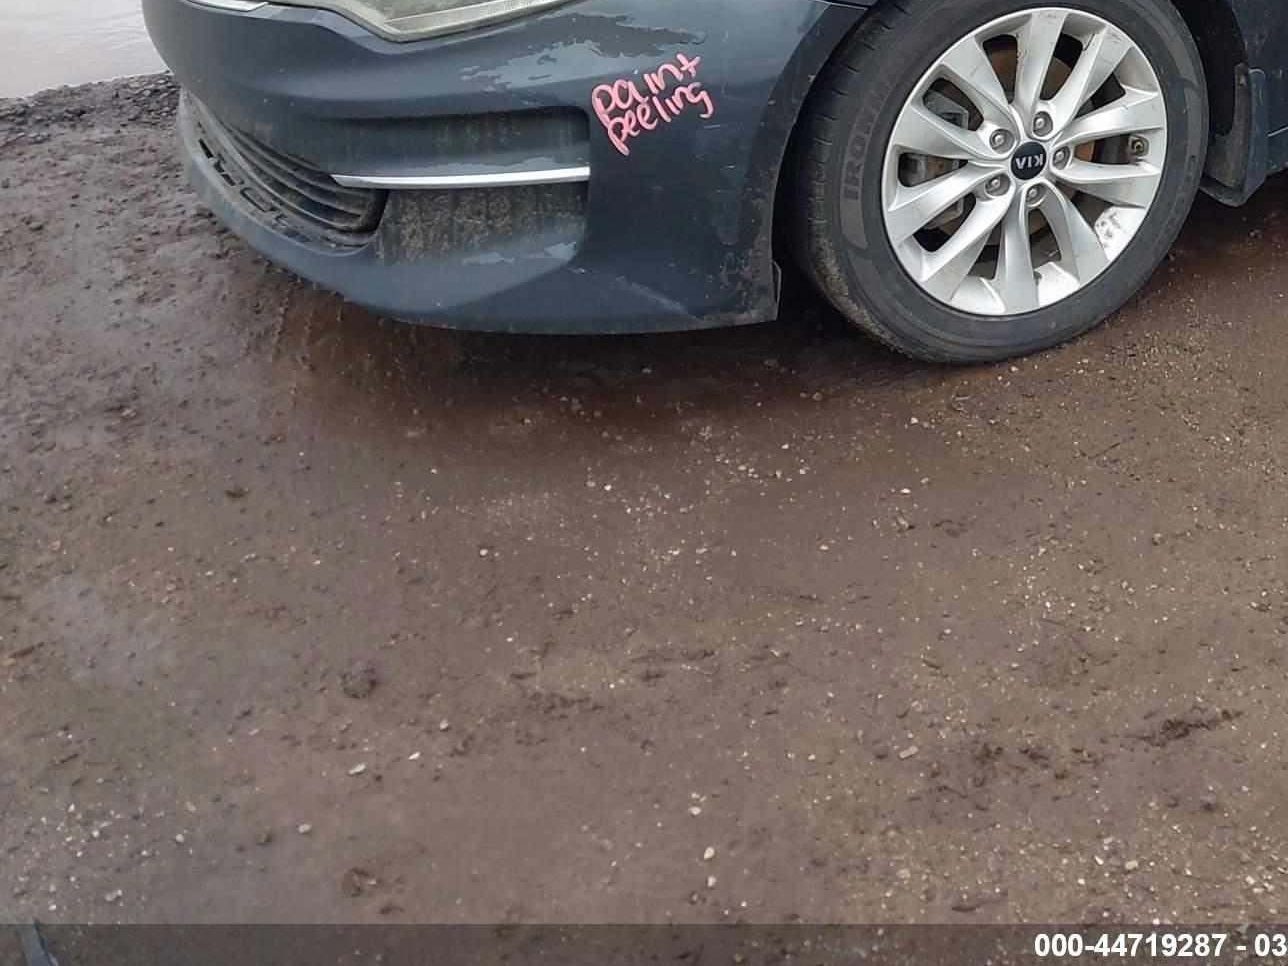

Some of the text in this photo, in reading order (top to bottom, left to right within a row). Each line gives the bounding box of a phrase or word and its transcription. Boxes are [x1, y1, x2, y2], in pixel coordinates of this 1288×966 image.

[591, 52, 701, 129] paint
[607, 81, 714, 156] peeling
[1015, 153, 1044, 170] KIA
